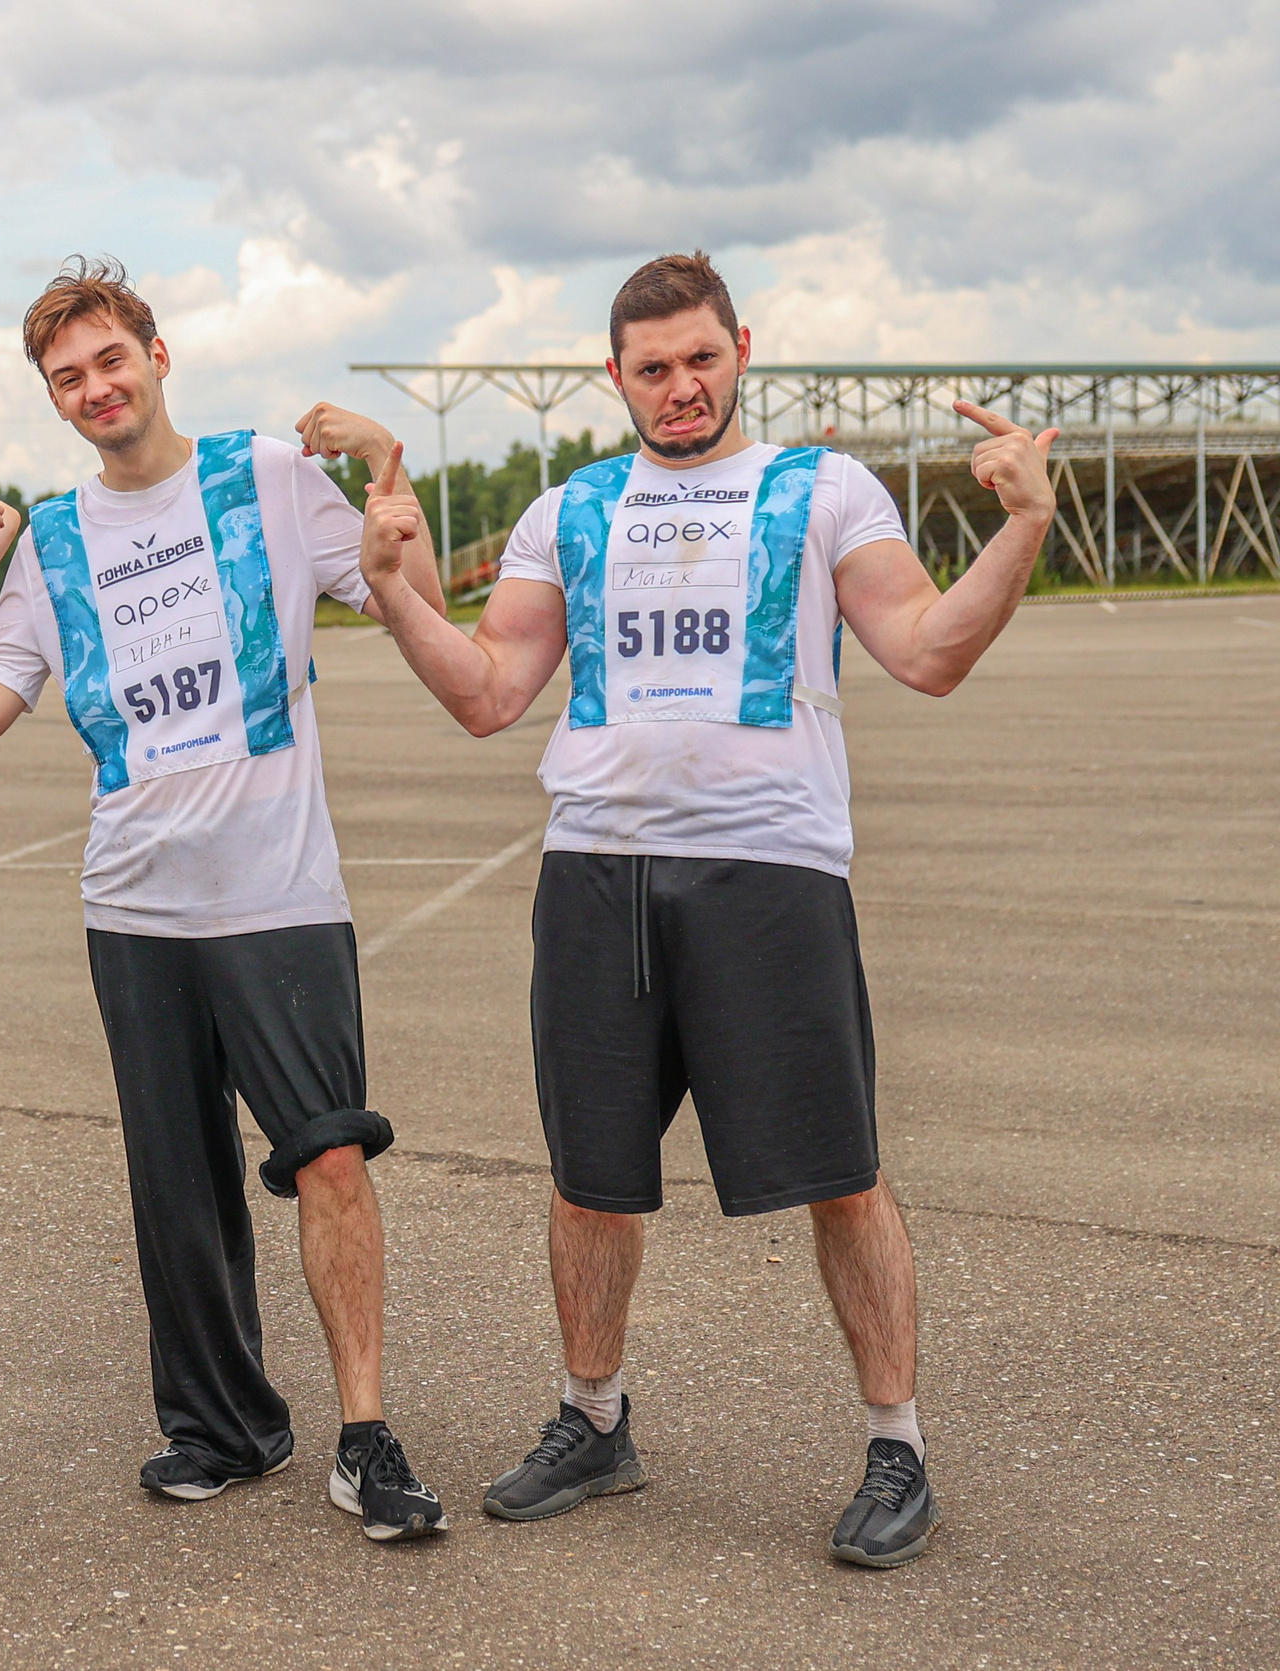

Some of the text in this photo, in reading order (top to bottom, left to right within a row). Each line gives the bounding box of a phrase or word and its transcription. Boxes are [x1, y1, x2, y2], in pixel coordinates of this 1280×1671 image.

[624, 490, 750, 504] ГОНКА ГЕРОЕВ
[627, 520, 733, 549] apex
[97, 536, 204, 586] ГОНКА ГЕРОЕВ
[114, 576, 203, 626] apex
[618, 608, 730, 658] 5188
[123, 659, 222, 724] 5187
[646, 687, 713, 698] ГАЗПРОМБАНК
[161, 733, 221, 755] ГАЗПРОМБАНК
